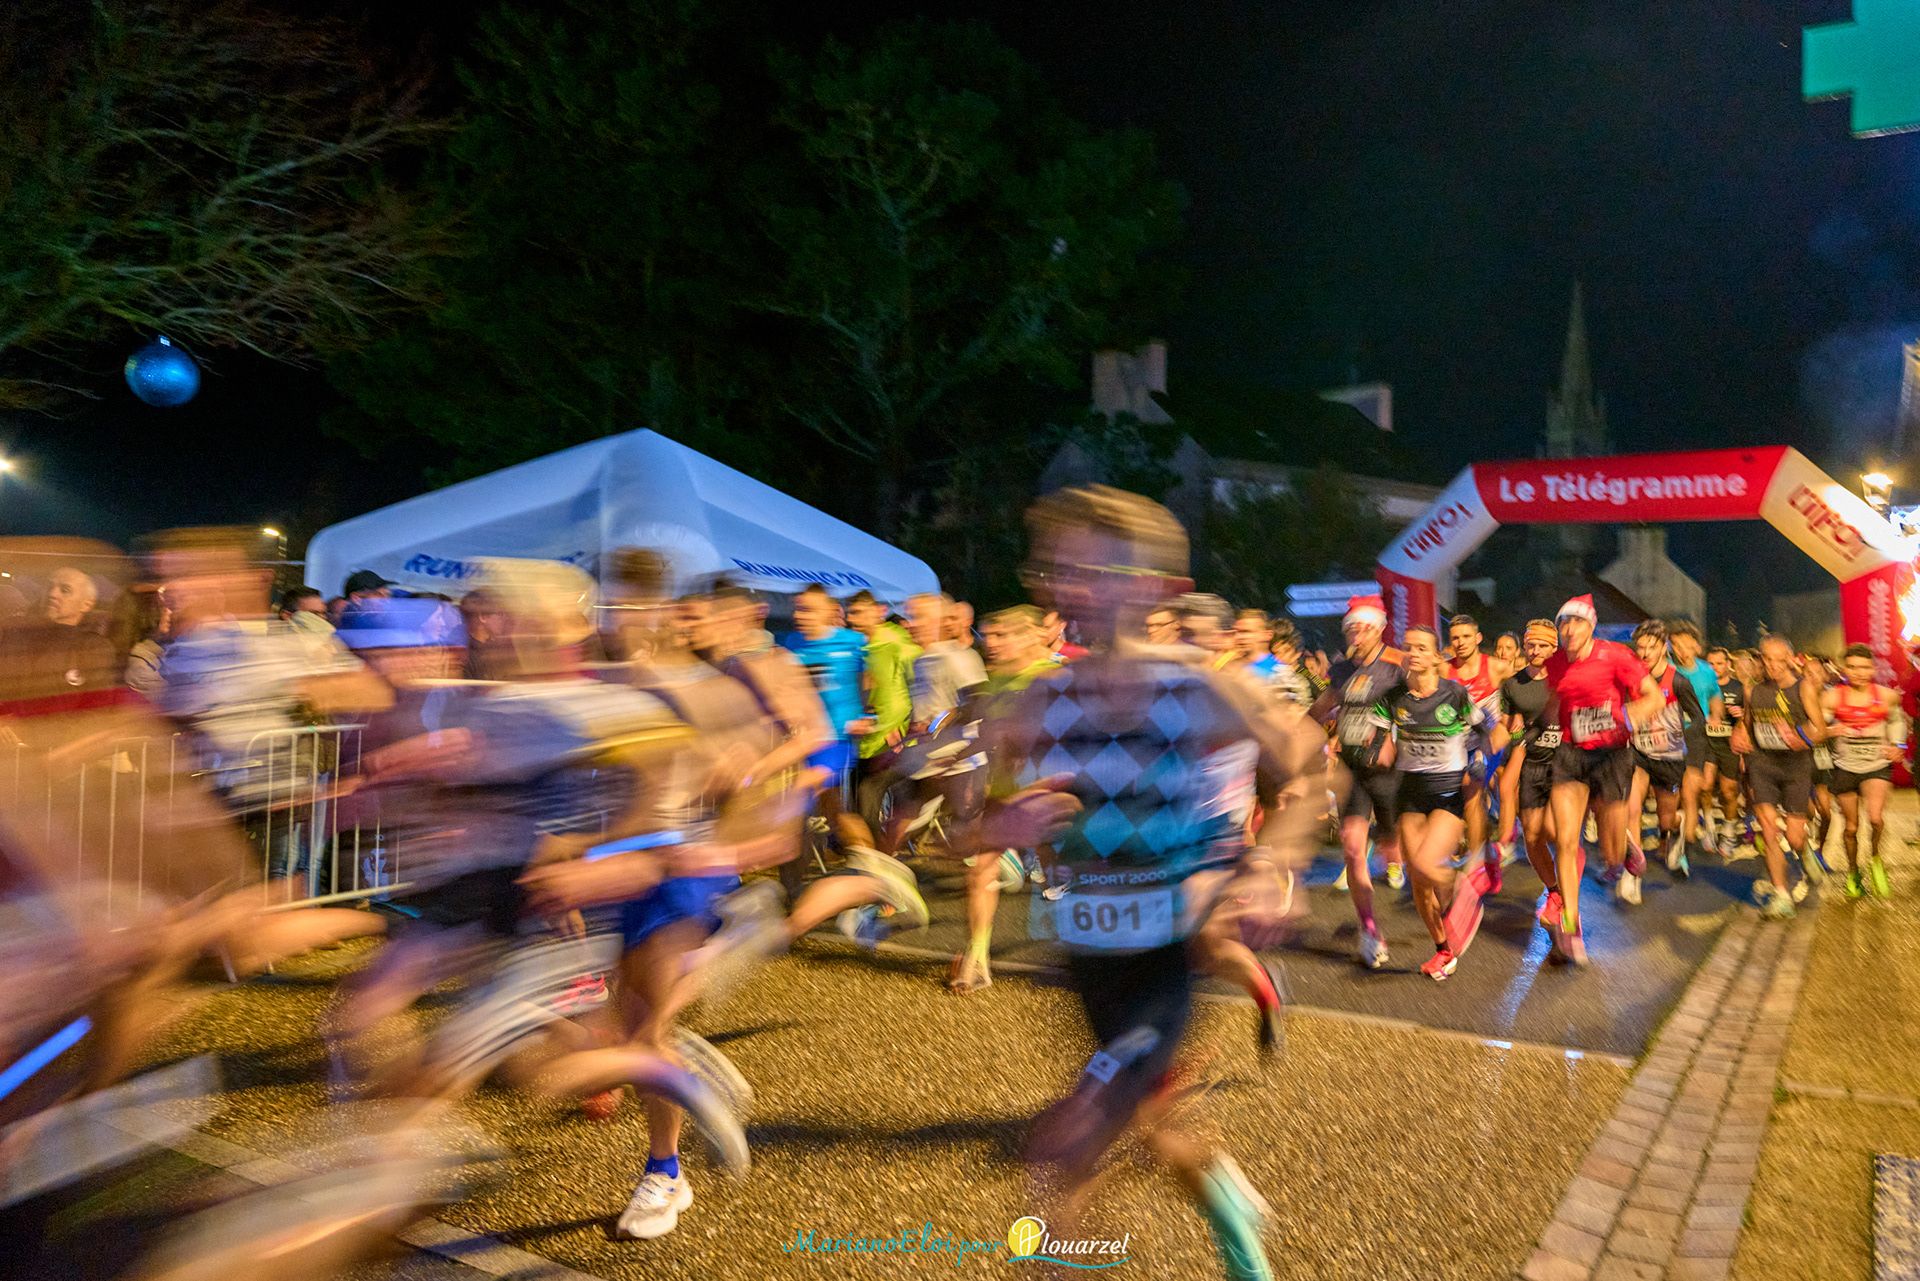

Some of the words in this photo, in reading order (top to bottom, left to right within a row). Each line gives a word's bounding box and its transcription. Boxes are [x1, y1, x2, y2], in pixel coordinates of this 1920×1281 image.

[1499, 476, 1535, 502] Le
[1542, 471, 1748, 505] Télégramme
[729, 557, 843, 587] RUNNING
[1079, 873, 1127, 886] SPORT
[1128, 869, 1168, 884] 2000
[1072, 900, 1142, 933] 601
